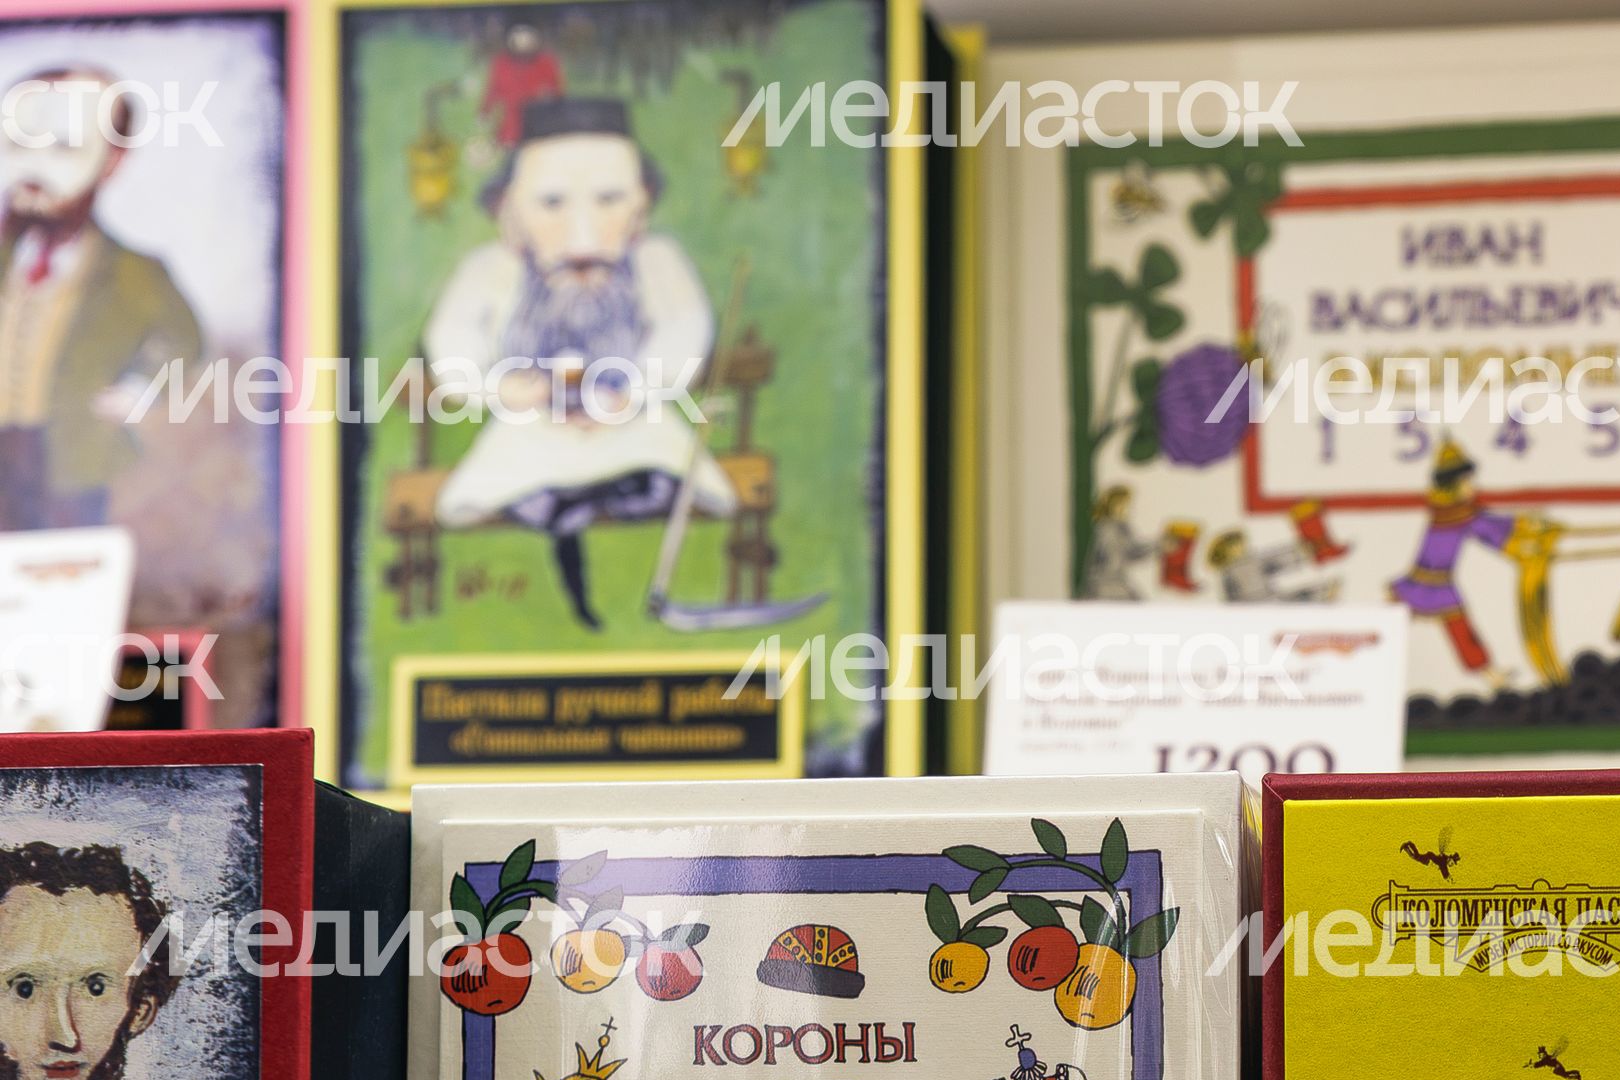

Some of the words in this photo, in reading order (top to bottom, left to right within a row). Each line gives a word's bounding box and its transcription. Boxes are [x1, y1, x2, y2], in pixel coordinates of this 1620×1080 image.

[1402, 222, 1545, 267] ИВАН
[1401, 897, 1566, 928] КОЛОМЕНСКАЯ
[1473, 943, 1509, 969] МУЗЕЙ
[1572, 937, 1614, 968] ВКУСОМ
[693, 1022, 917, 1066] КОРОНЫ
